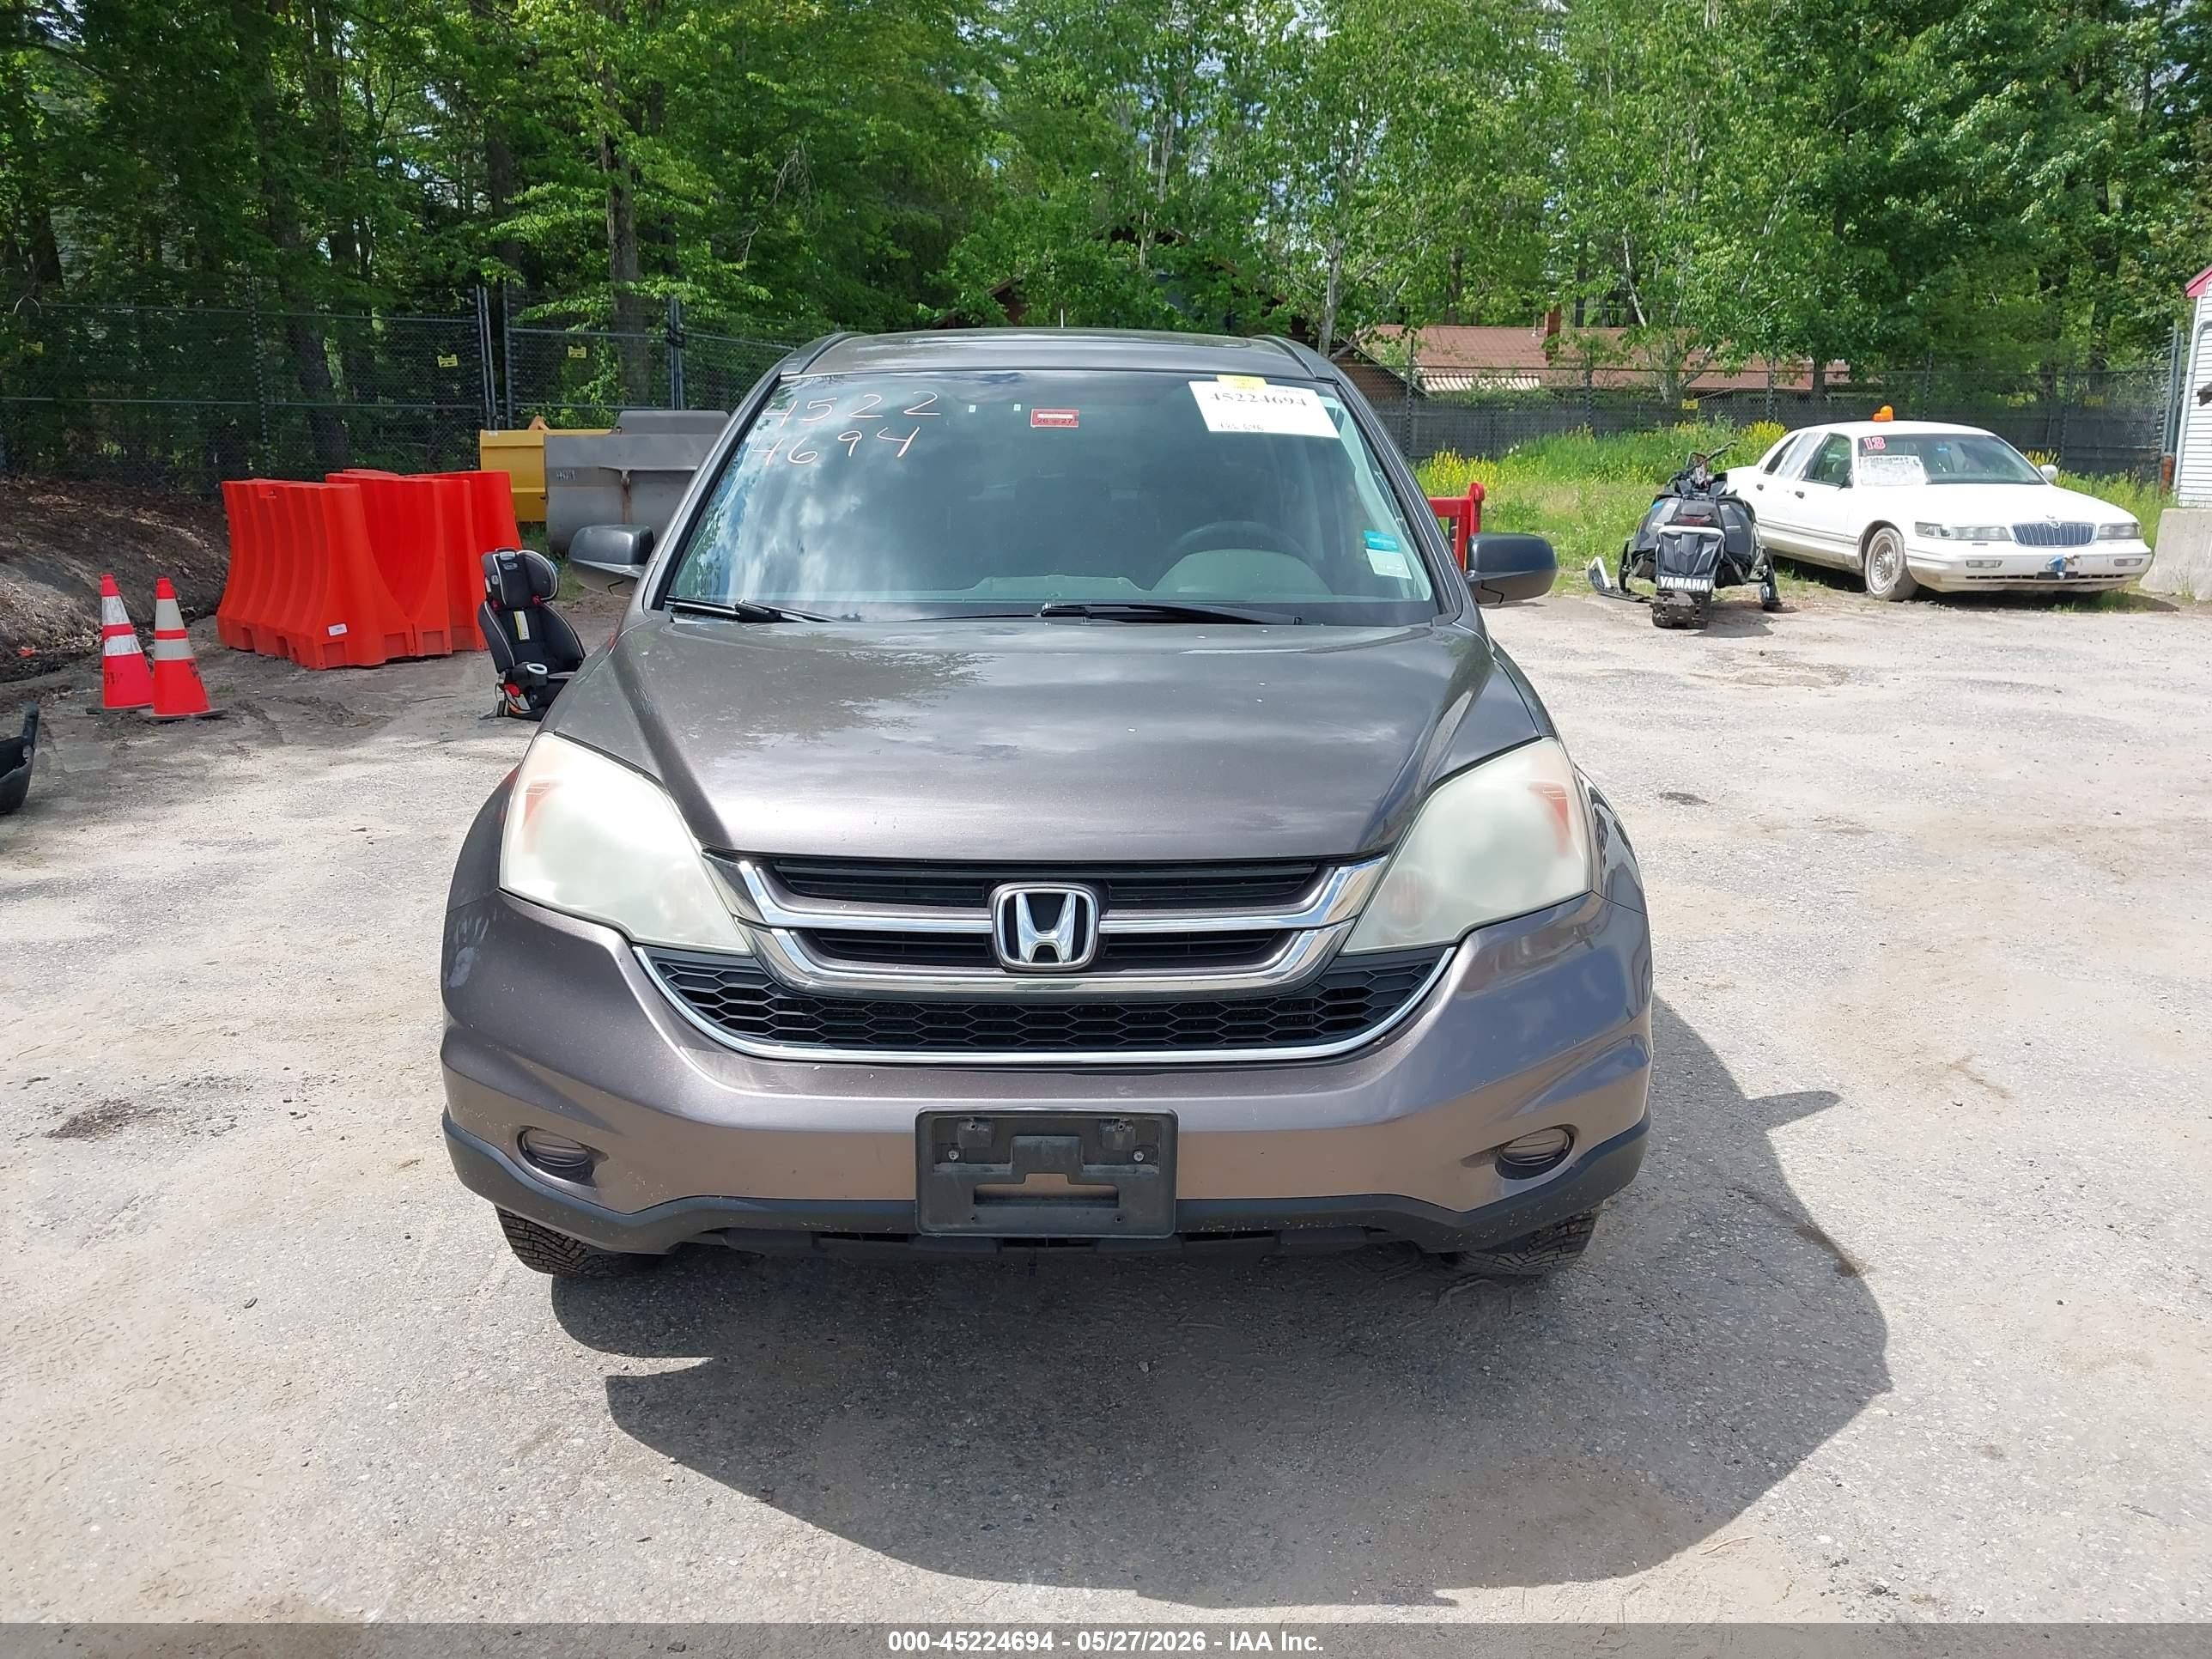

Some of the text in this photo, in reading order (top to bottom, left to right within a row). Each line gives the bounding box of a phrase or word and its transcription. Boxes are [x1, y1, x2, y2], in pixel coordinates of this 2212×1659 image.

[762, 391, 942, 428] 4522
[750, 426, 921, 466] 4694
[1659, 576, 1709, 592] YAMAHA
